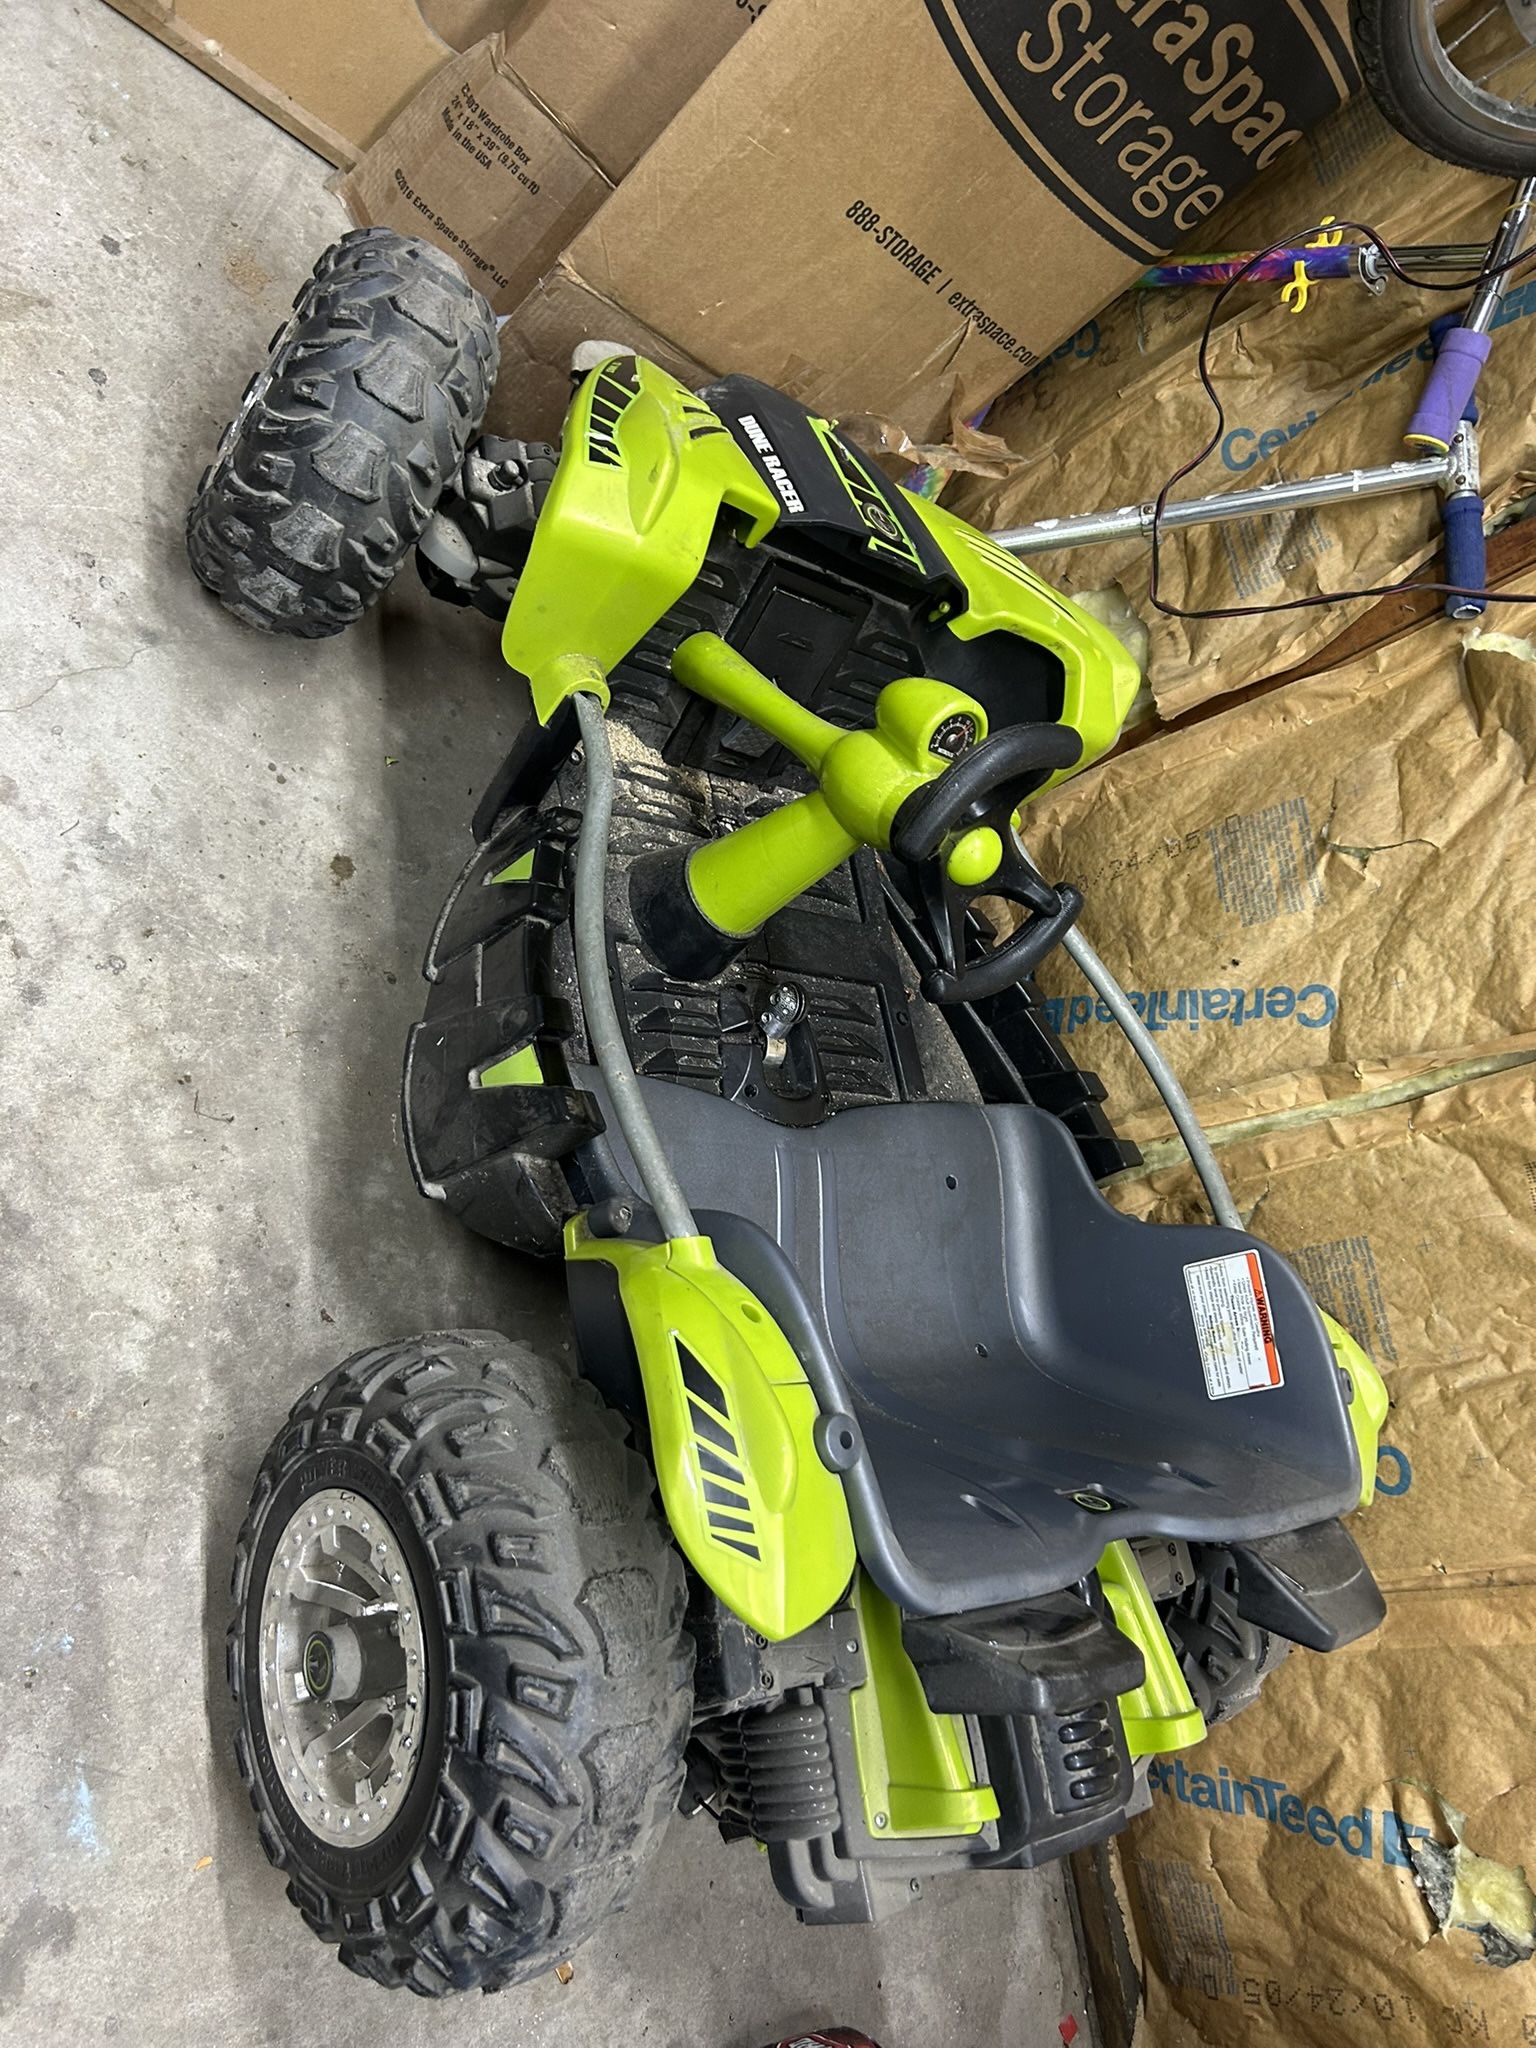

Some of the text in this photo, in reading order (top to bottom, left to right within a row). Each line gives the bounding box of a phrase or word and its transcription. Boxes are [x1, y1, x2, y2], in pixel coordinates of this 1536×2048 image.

[1017, 0, 1224, 231] Storage
[1115, 0, 1303, 170] raSpac
[442, 106, 493, 170] Made in the USA
[476, 132, 484, 141] x
[497, 151, 520, 175] (9.75
[517, 172, 530, 186] cu
[527, 181, 540, 195] ft)
[478, 109, 515, 149] Wardrobe
[514, 146, 531, 165] Box
[412, 196, 435, 221] Extra
[434, 216, 459, 243] Space
[492, 271, 509, 289] LLC
[845, 200, 942, 285] 888-STORAGE
[738, 414, 805, 514] DUNE RACER
[1068, 984, 1337, 1034] CertainTeed
[1255, 1294, 1273, 1344] WARNING
[1147, 1759, 1373, 1860] ertainTeed
